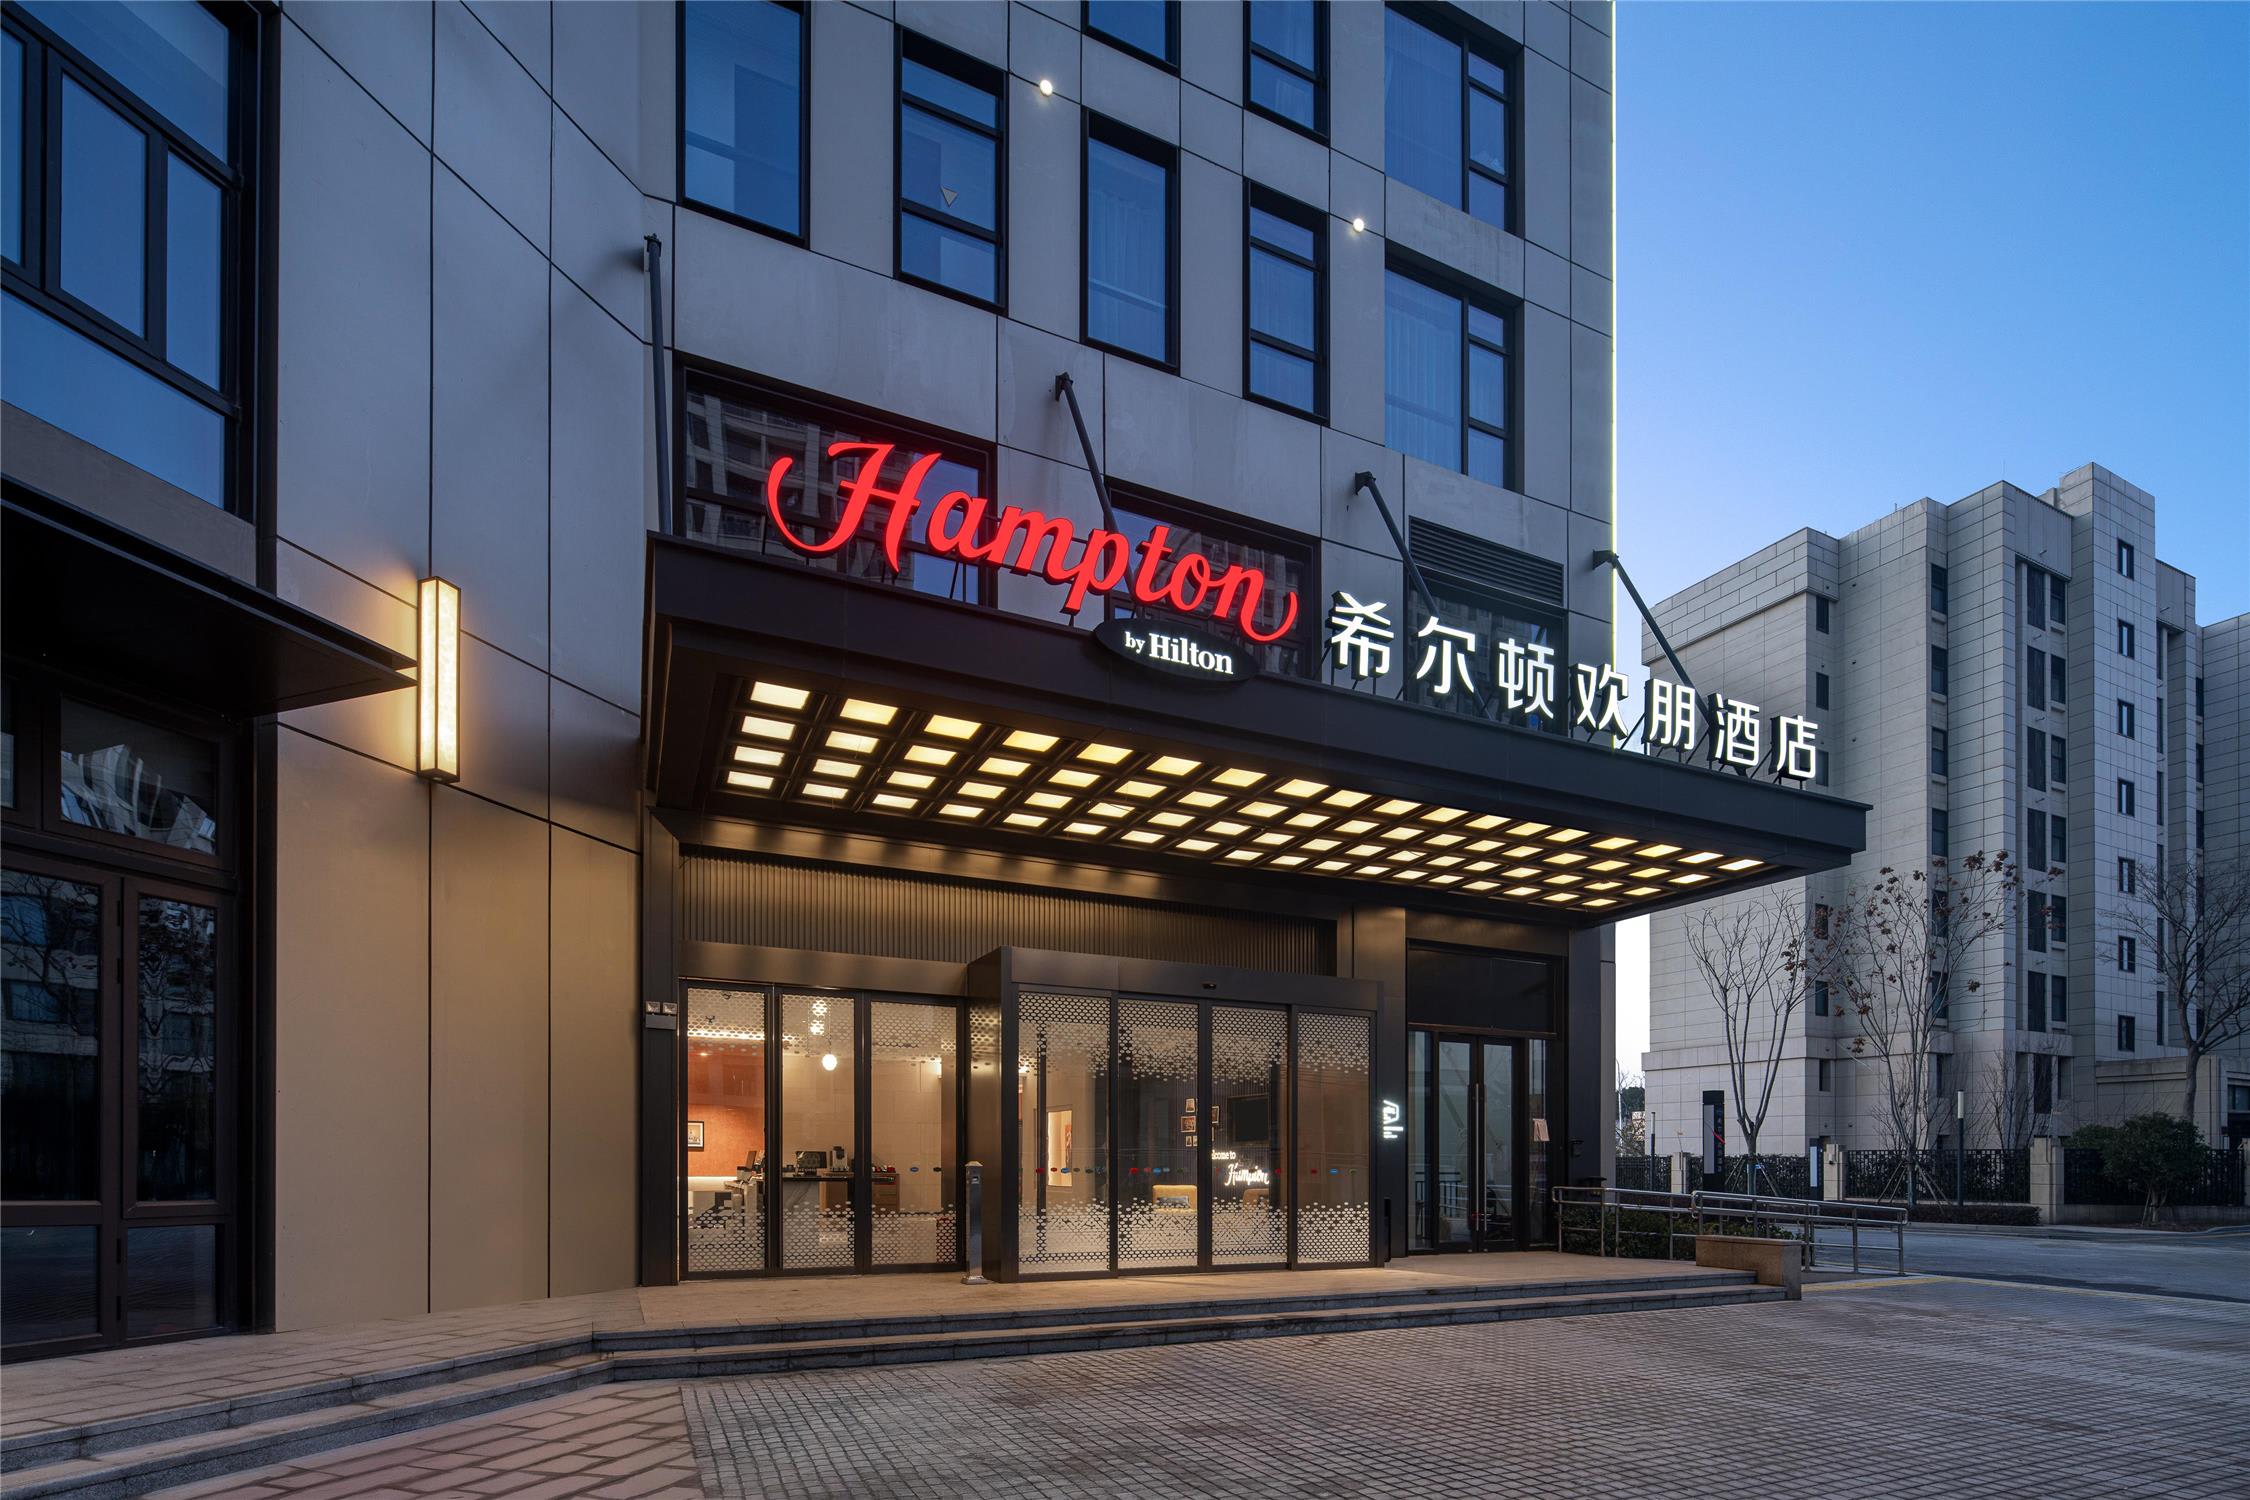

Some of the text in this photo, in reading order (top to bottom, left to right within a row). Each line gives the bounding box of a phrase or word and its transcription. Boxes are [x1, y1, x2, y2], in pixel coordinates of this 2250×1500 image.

[767, 441, 1298, 642] Hampton
[1125, 631, 1234, 674] by Hilton
[1331, 591, 1818, 779] 希尔顿欢朋酒店
